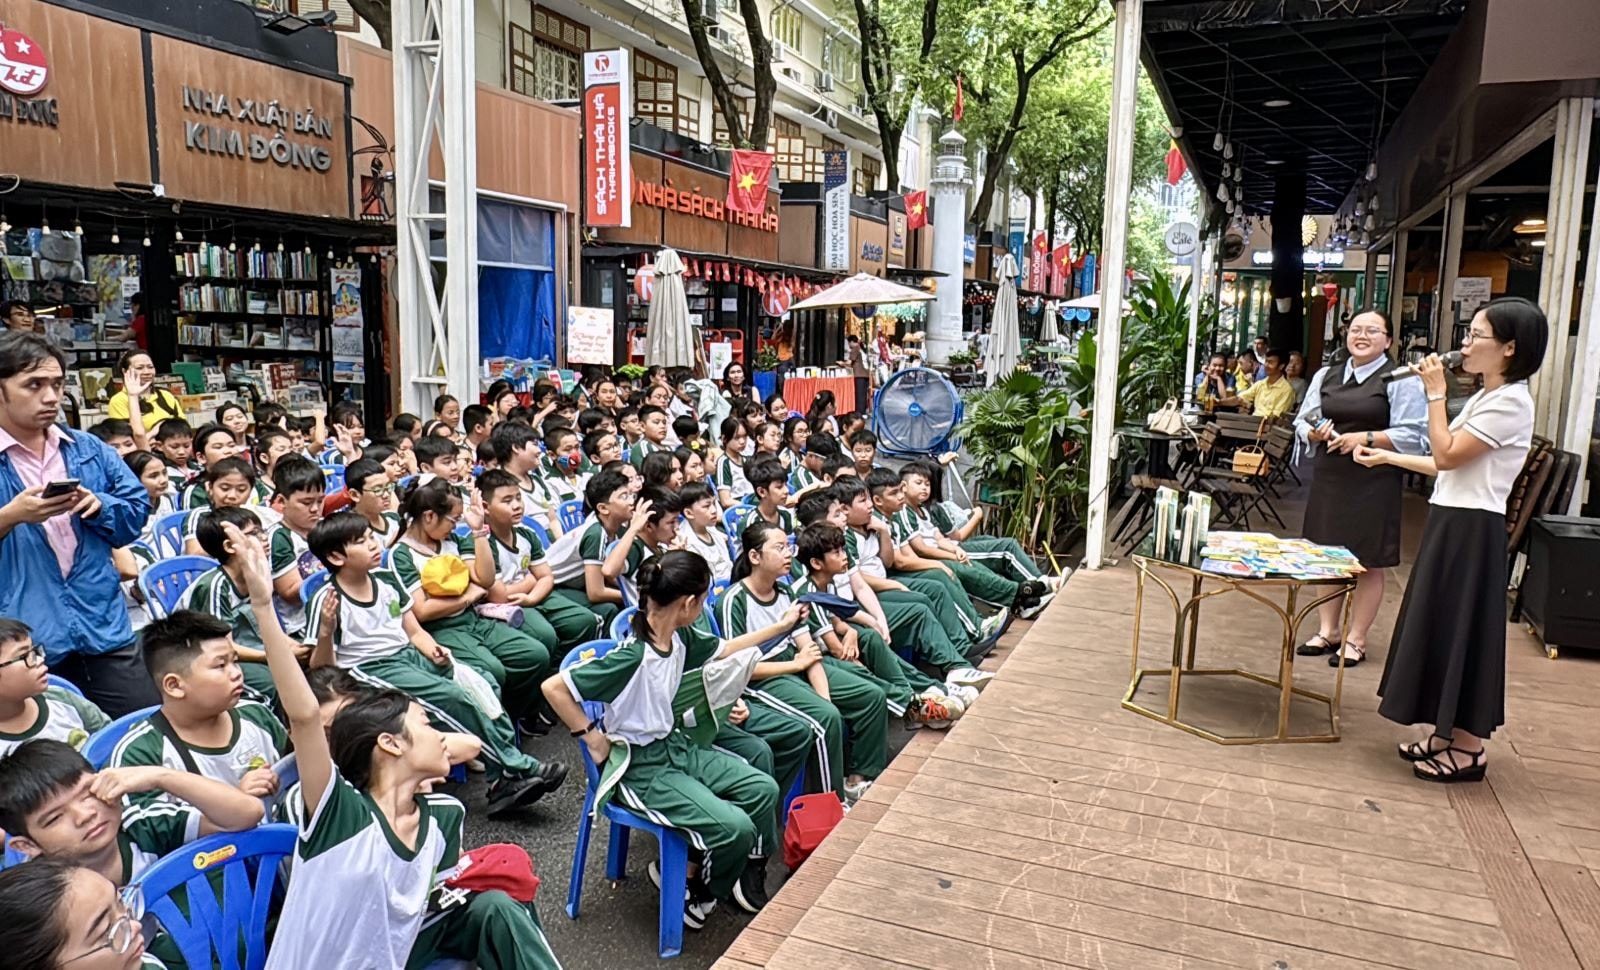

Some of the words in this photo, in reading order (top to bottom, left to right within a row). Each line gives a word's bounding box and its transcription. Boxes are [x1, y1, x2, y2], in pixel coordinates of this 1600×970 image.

[593, 93, 605, 119] HÀ
[184, 120, 245, 158] KIM
[249, 130, 332, 171] ĐỒNG
[594, 123, 606, 164] THÁI
[607, 106, 616, 201] THAIHABOOKS
[595, 167, 607, 215] SÁCH
[638, 179, 677, 209] NHÀ
[679, 186, 724, 221] SÁCH
[760, 206, 778, 233] HÀ
[831, 192, 839, 208] SEN
[831, 210, 839, 229] HOA
